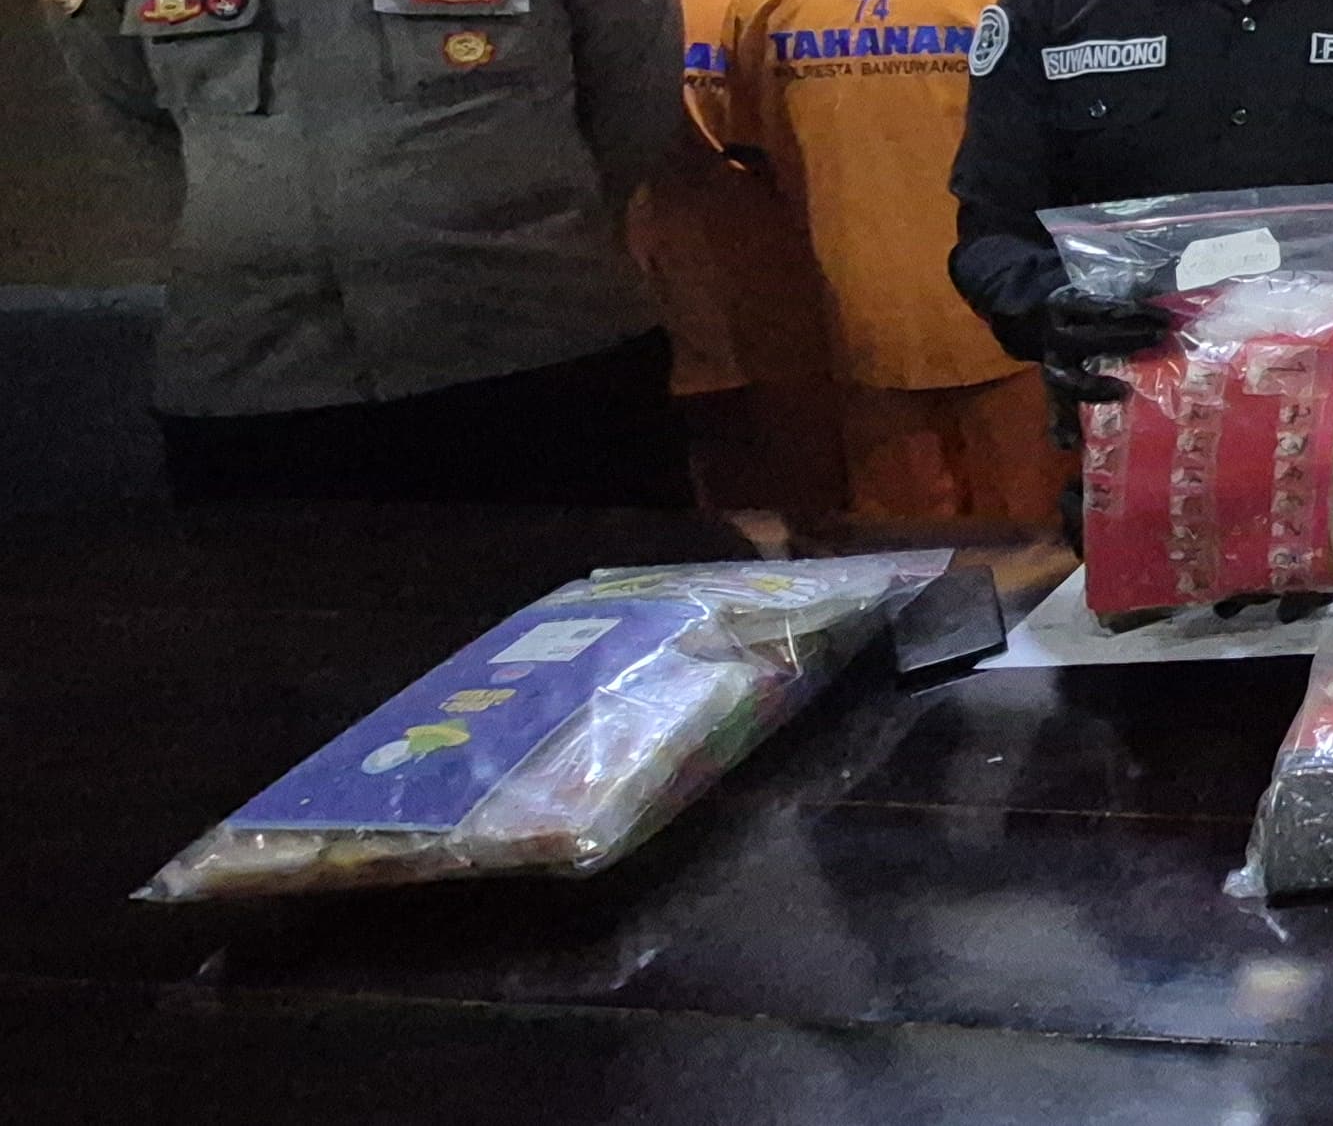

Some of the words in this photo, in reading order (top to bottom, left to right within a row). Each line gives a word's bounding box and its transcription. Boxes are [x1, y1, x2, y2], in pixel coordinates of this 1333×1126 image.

[769, 25, 975, 62] TAHANAN
[1048, 41, 1162, 77] SUWANDONO
[860, 56, 969, 76] BANYUWANG
